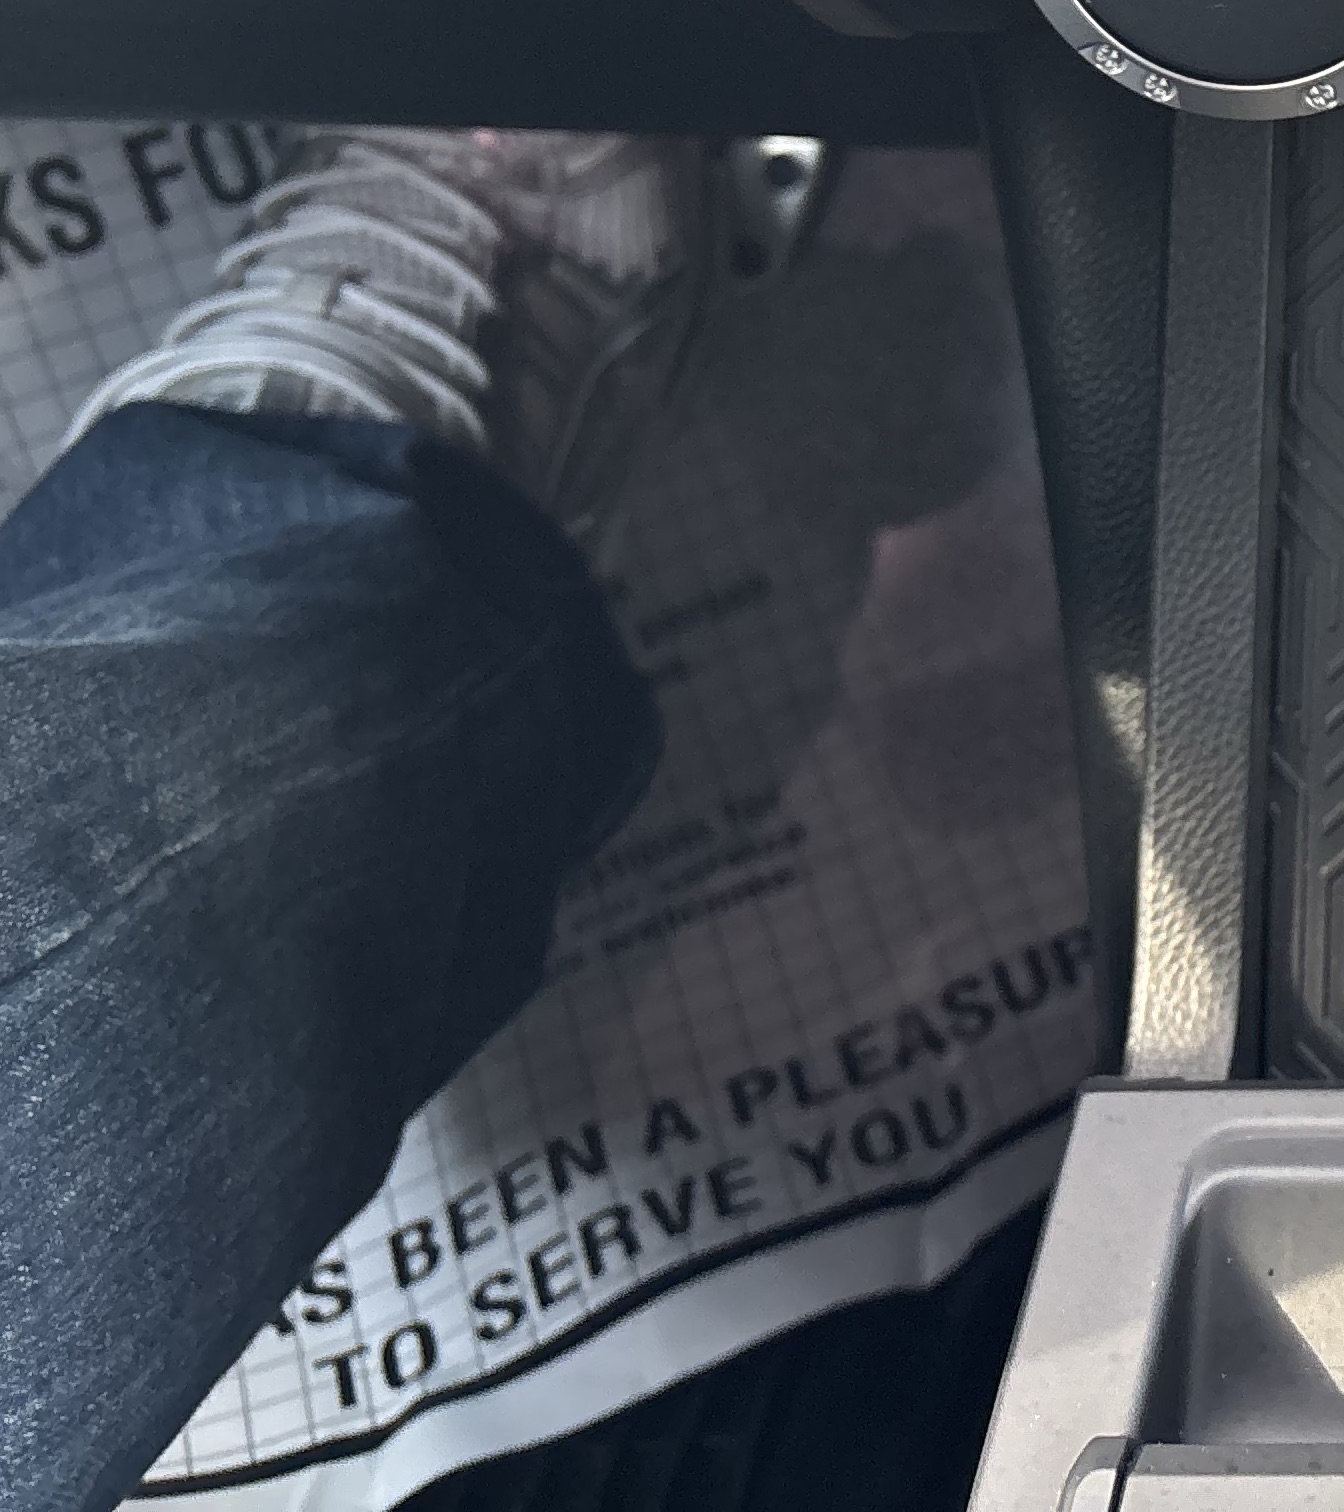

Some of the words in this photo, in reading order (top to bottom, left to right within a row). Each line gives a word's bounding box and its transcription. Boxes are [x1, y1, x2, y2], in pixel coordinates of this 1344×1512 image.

[312, 1320, 439, 1409] TO
[469, 1154, 764, 1343] SERVE
[789, 1084, 971, 1189] YOU
[386, 1119, 604, 1288] BEEN
[643, 1096, 702, 1157] A
